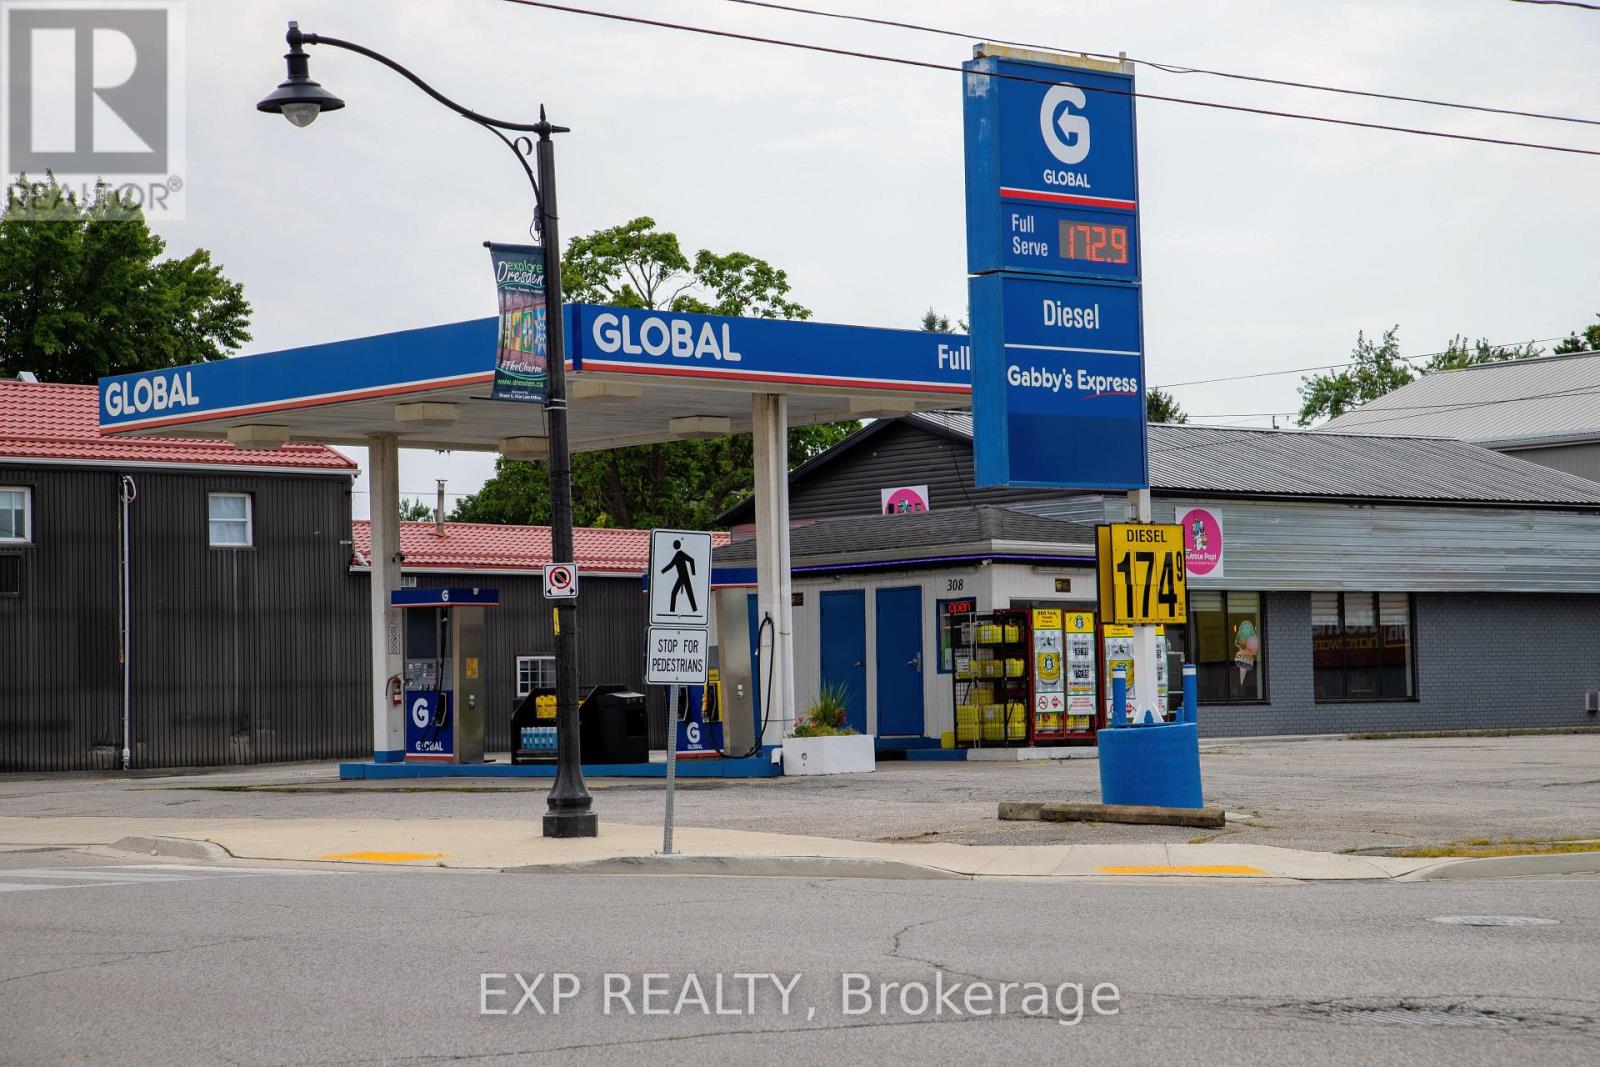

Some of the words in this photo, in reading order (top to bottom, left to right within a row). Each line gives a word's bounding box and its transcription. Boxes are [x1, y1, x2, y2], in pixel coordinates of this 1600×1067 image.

[1043, 169, 1091, 189] GLOBAL
[1011, 213, 1035, 234] Full
[1012, 236, 1049, 258] Serve
[1068, 223, 1128, 264] 172.9
[497, 261, 544, 286] Dresden
[507, 260, 542, 273] explore
[1043, 299, 1100, 330] Diesel
[592, 312, 742, 362] GLOBAL
[937, 344, 971, 371] Full
[497, 379, 544, 388] www.dresden.ca
[1007, 365, 1073, 393] Gabby's
[1077, 369, 1138, 395] Express
[105, 371, 200, 417] GLOBAL
[1126, 529, 1168, 543] DIESEL
[946, 578, 964, 591] 308
[948, 602, 971, 614] open
[658, 639, 678, 653] STOP
[683, 640, 699, 654] FOR
[652, 657, 703, 673] PEDESTRIANS
[412, 698, 429, 728] G
